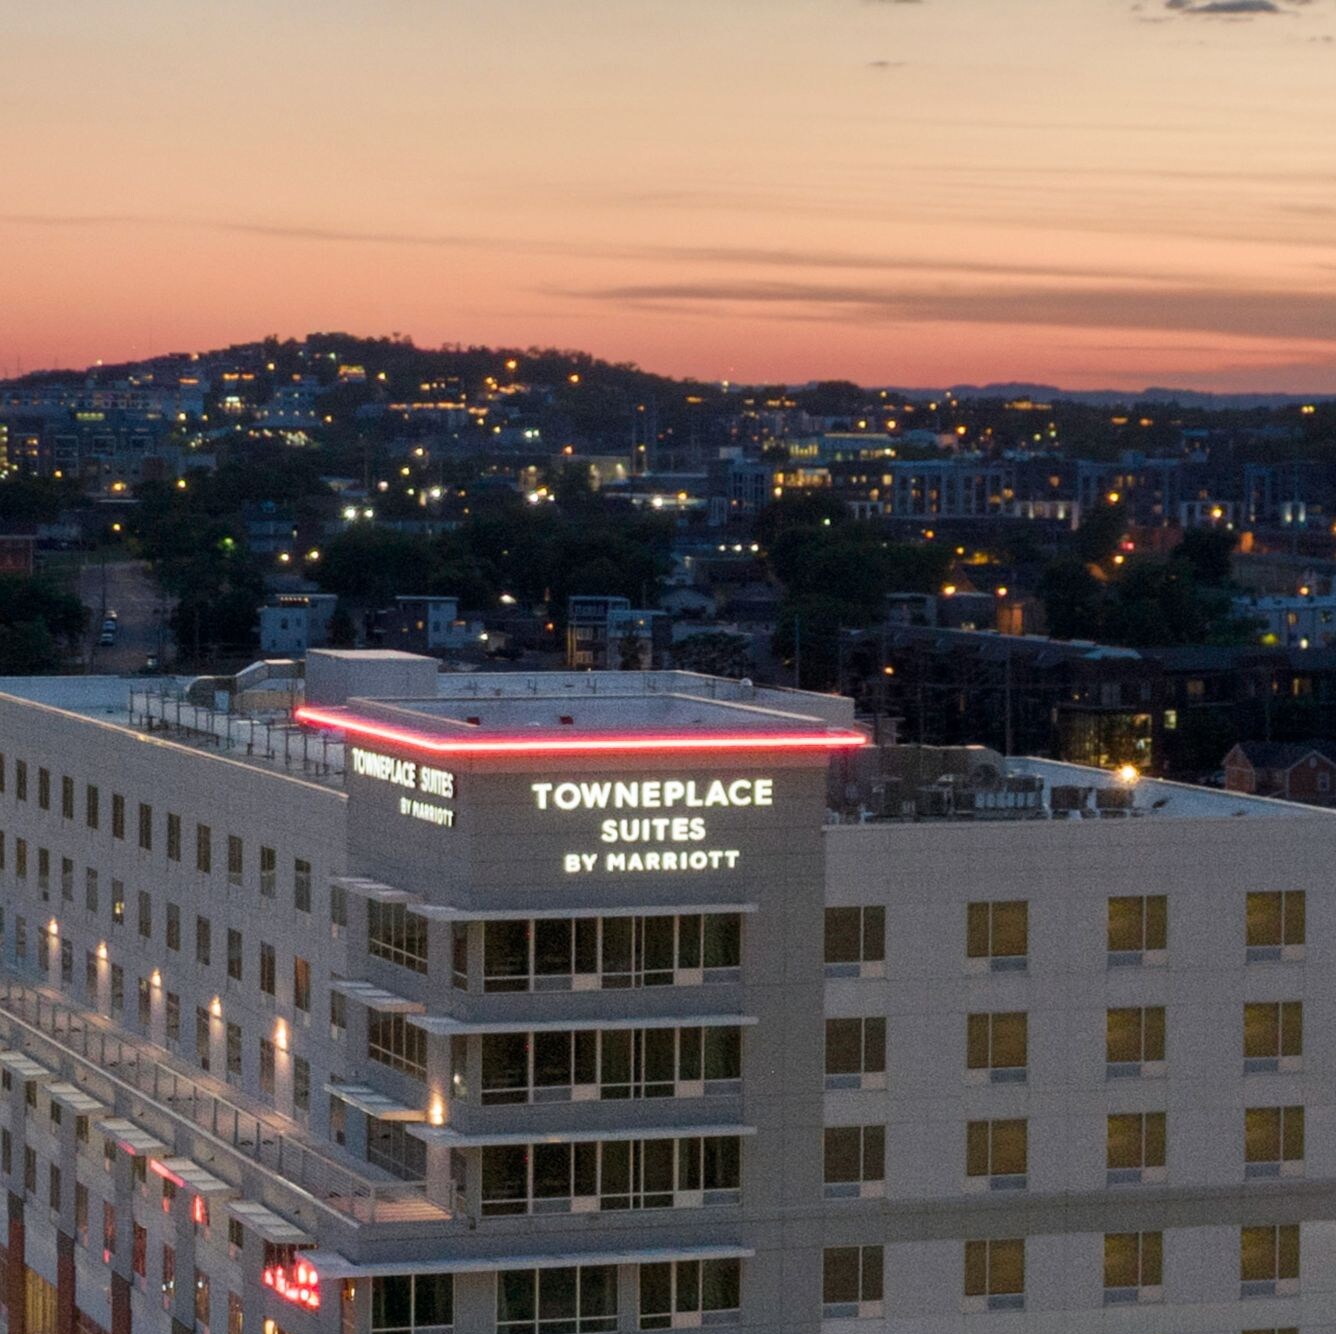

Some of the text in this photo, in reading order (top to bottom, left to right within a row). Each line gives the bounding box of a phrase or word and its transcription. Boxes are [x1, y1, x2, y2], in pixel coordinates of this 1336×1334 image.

[352, 747, 454, 798] TOWNEPLACE SUITES
[531, 779, 773, 810] TOWNEPLACE
[400, 797, 453, 827] BY MARRIOTT
[601, 817, 706, 843] SUITES
[564, 850, 740, 873] BY MARRIOTT
